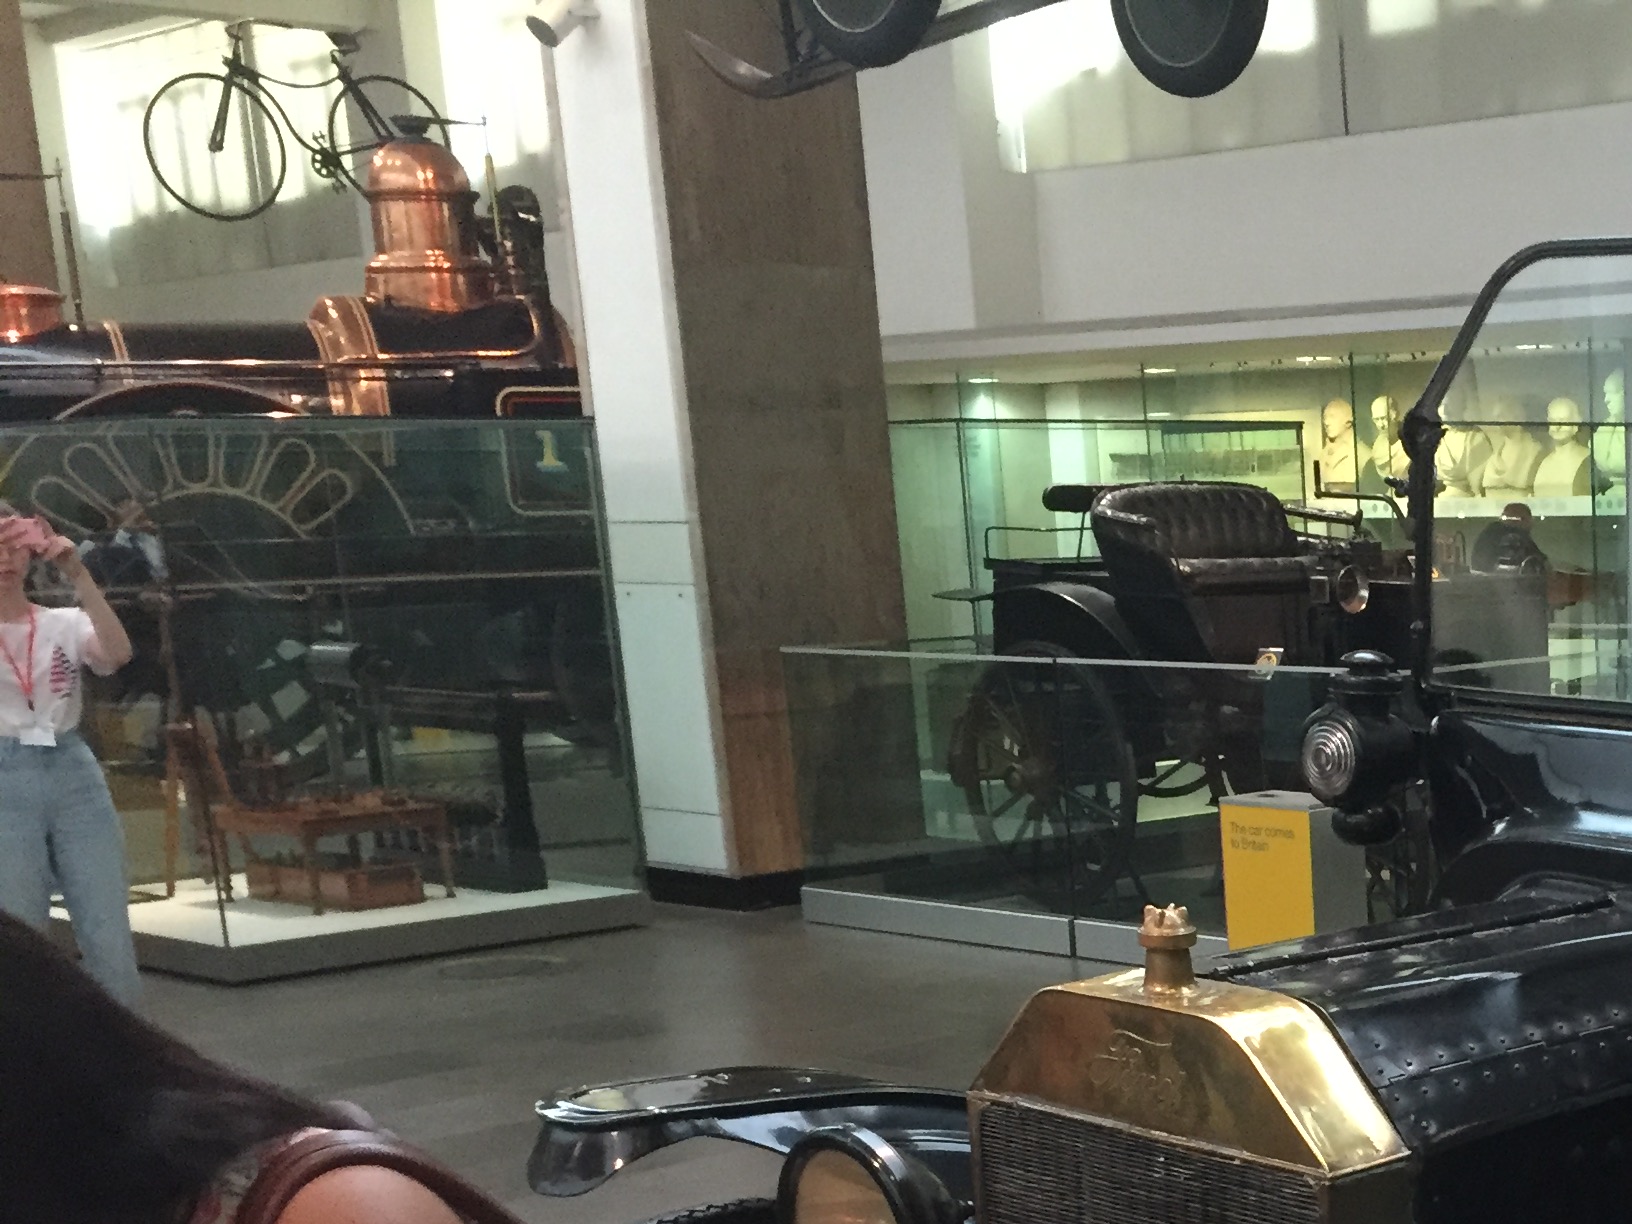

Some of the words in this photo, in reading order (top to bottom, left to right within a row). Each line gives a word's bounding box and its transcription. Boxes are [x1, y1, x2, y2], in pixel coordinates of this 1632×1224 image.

[535, 430, 569, 472] 1
[1230, 821, 1246, 835] The
[1249, 826, 1262, 836] car
[1264, 827, 1295, 839] comes
[1231, 838, 1240, 849] to
[1241, 837, 1270, 852] Britain
